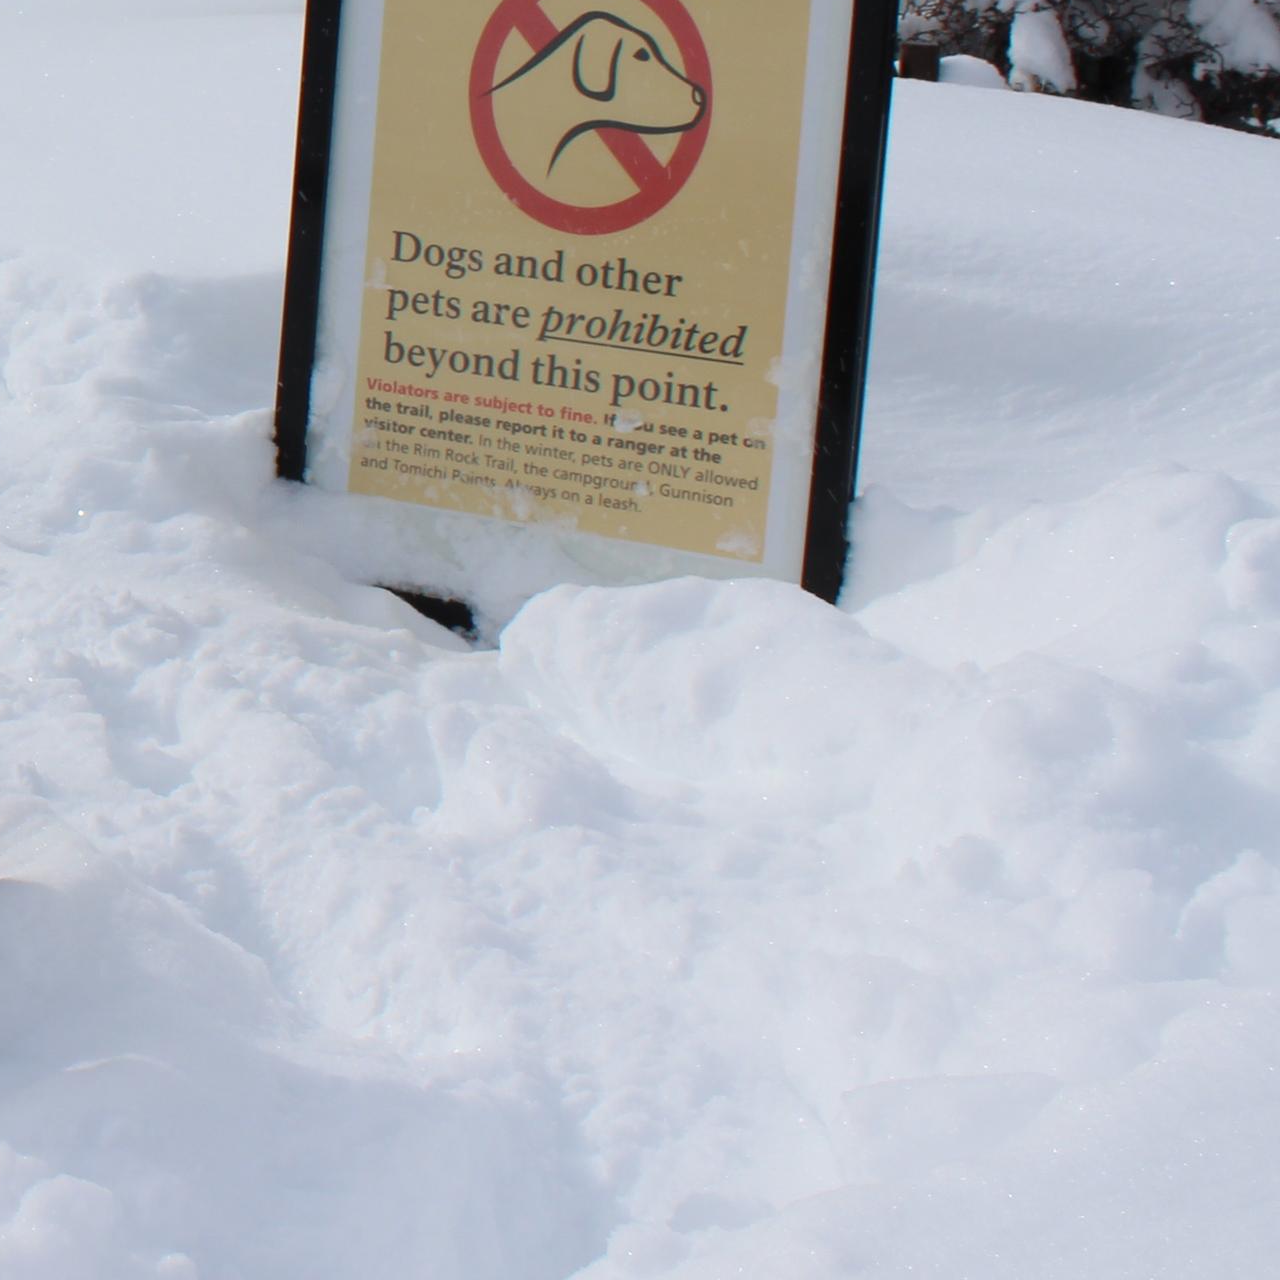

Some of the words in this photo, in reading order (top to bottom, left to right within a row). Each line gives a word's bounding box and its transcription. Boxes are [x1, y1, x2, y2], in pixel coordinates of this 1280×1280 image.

[390, 229, 484, 280] Dogs
[493, 250, 565, 283] and
[575, 257, 684, 298] other
[384, 288, 462, 321] pets
[470, 299, 532, 329] are
[536, 305, 748, 359] prohibited
[383, 330, 521, 383] beyond
[530, 353, 602, 394] this
[609, 371, 729, 413] point.
[365, 397, 392, 413] the
[396, 401, 434, 420] trail,
[438, 409, 492, 428] please
[495, 419, 547, 438] report
[552, 425, 565, 439] it
[569, 429, 588, 444] to
[591, 433, 603, 446] a
[607, 436, 666, 456] ranger
[669, 444, 689, 460] at
[692, 447, 722, 465] the
[366, 376, 440, 401] Violators
[443, 390, 471, 405] are
[473, 394, 533, 416] subject
[537, 404, 555, 419] to
[560, 406, 598, 425] fine.
[659, 422, 689, 438] see
[692, 428, 704, 441] a
[707, 431, 739, 446] pet
[743, 437, 767, 450] on
[359, 456, 389, 471] and
[392, 459, 448, 480] Tomichi
[560, 489, 580, 502] on
[584, 493, 594, 506] a
[598, 493, 642, 513] leash.
[364, 417, 417, 436] visitor
[419, 425, 474, 445] center.
[478, 434, 492, 449] In
[496, 436, 521, 453] the
[524, 445, 577, 464] winter,
[580, 451, 614, 468] pets
[617, 458, 644, 473] are
[647, 460, 692, 480] ONLY
[694, 470, 760, 491] allowed
[385, 439, 410, 455] the
[413, 442, 440, 460] Rim
[444, 447, 481, 467] Rock
[484, 454, 518, 475] Trail,
[522, 462, 549, 478] the
[552, 468, 655, 497] campgroun,
[658, 483, 735, 508] Gunnison
